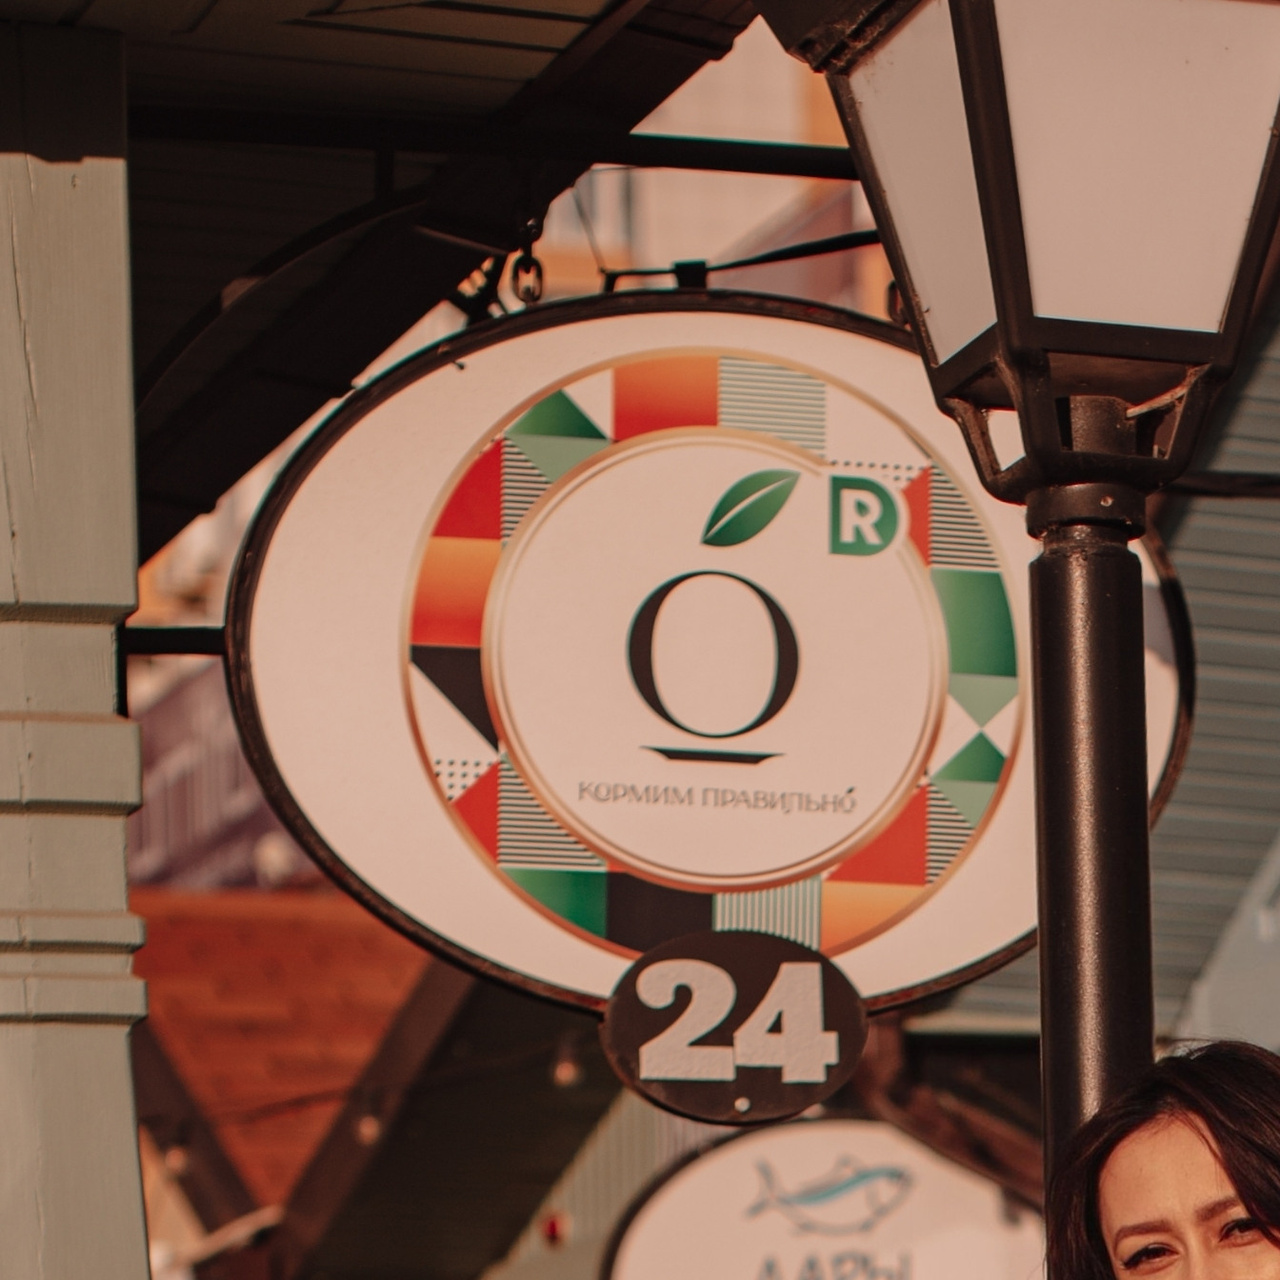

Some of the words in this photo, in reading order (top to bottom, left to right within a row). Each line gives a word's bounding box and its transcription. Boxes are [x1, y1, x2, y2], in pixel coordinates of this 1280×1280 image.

[578, 781, 695, 806] КОРМИМ
[701, 786, 858, 815] ПРАВИЛЬНО
[636, 959, 840, 1084] 24
